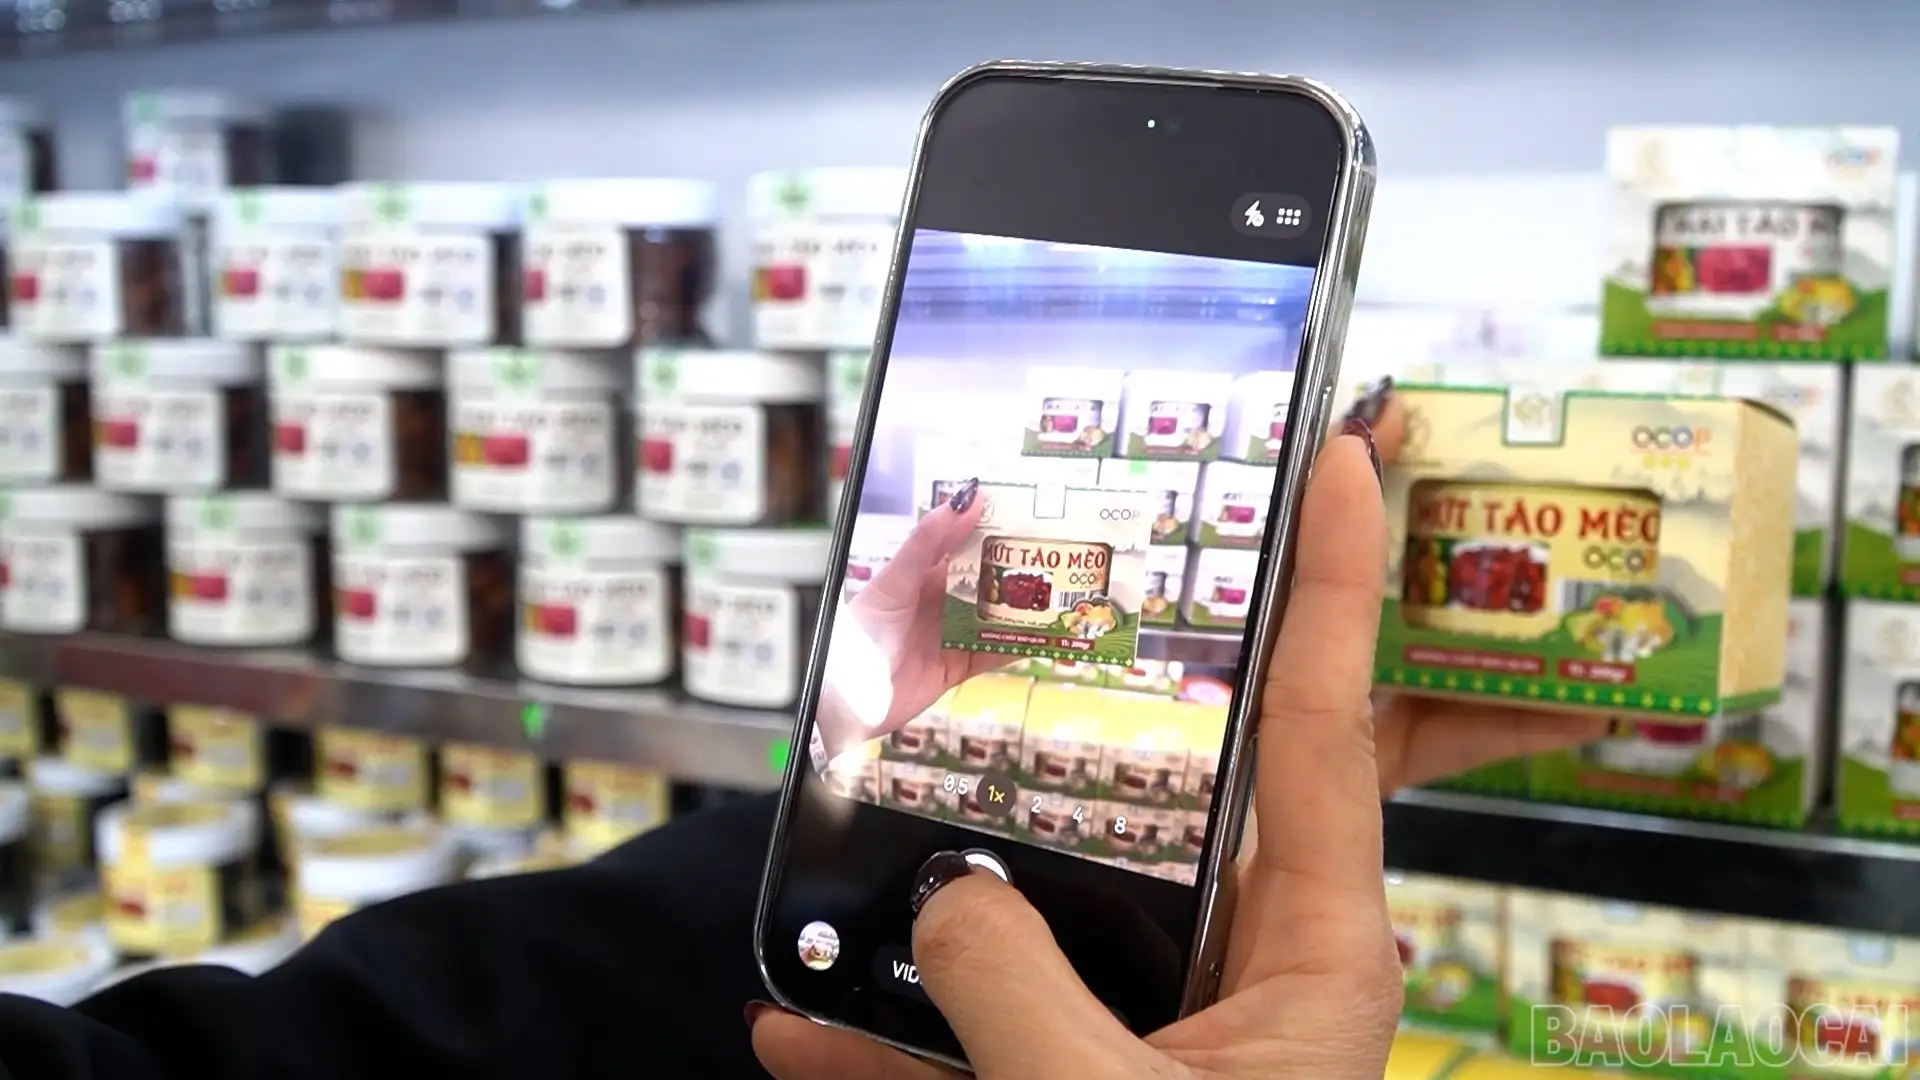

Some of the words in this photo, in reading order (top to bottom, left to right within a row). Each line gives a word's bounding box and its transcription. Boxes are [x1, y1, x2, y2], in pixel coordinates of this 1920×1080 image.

[1631, 424, 1712, 453] OCOP
[943, 774, 969, 795] 0,5
[988, 785, 1005, 803] 1x
[1031, 796, 1043, 813] 2
[1073, 806, 1083, 824] 4
[1114, 816, 1127, 834] 8
[893, 960, 922, 984] VID
